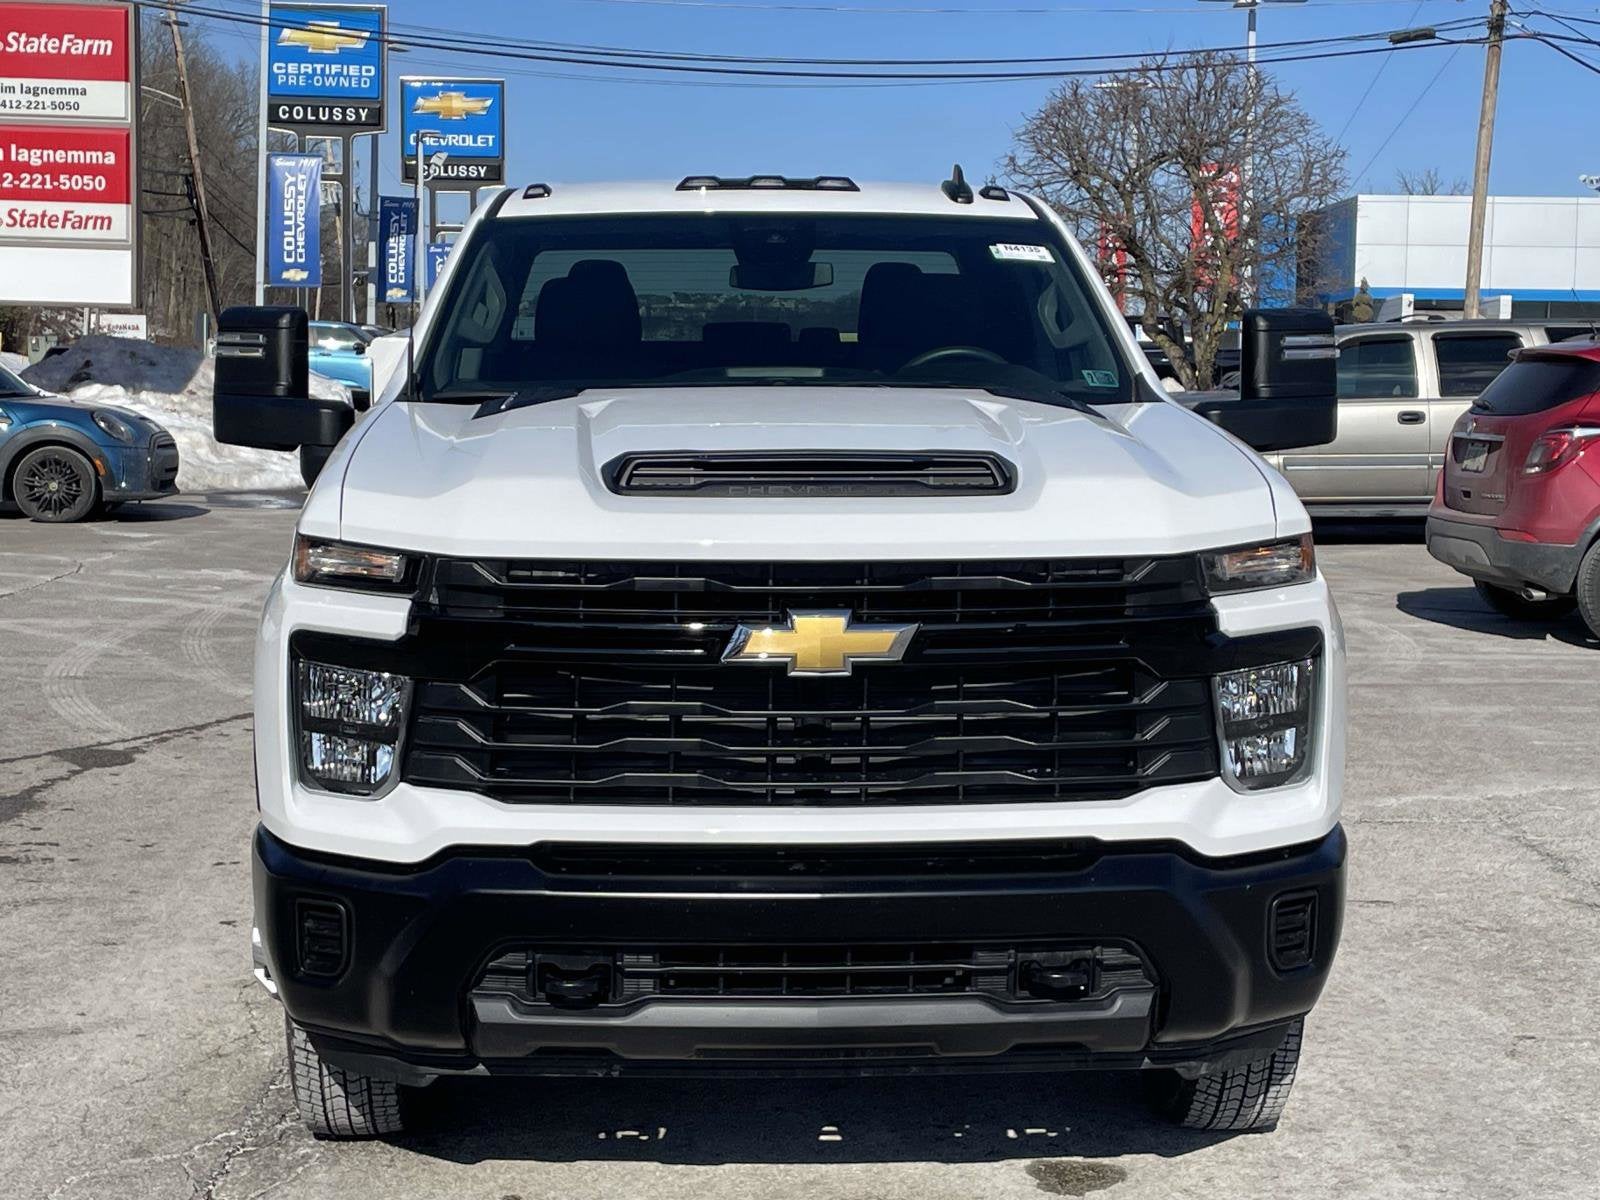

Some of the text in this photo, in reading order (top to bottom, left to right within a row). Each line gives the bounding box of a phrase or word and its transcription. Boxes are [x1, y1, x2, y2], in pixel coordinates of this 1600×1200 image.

[272, 62, 376, 77] CERTIFIED
[278, 75, 371, 88] PRE-OWNED
[278, 105, 369, 121] COLUSSY
[409, 133, 496, 147] CHEVROLET
[0, 172, 106, 191] 2-221-5050
[283, 172, 296, 263] COLUSSY
[296, 174, 307, 263] CHEVROLET
[388, 212, 400, 284] COLUSSY
